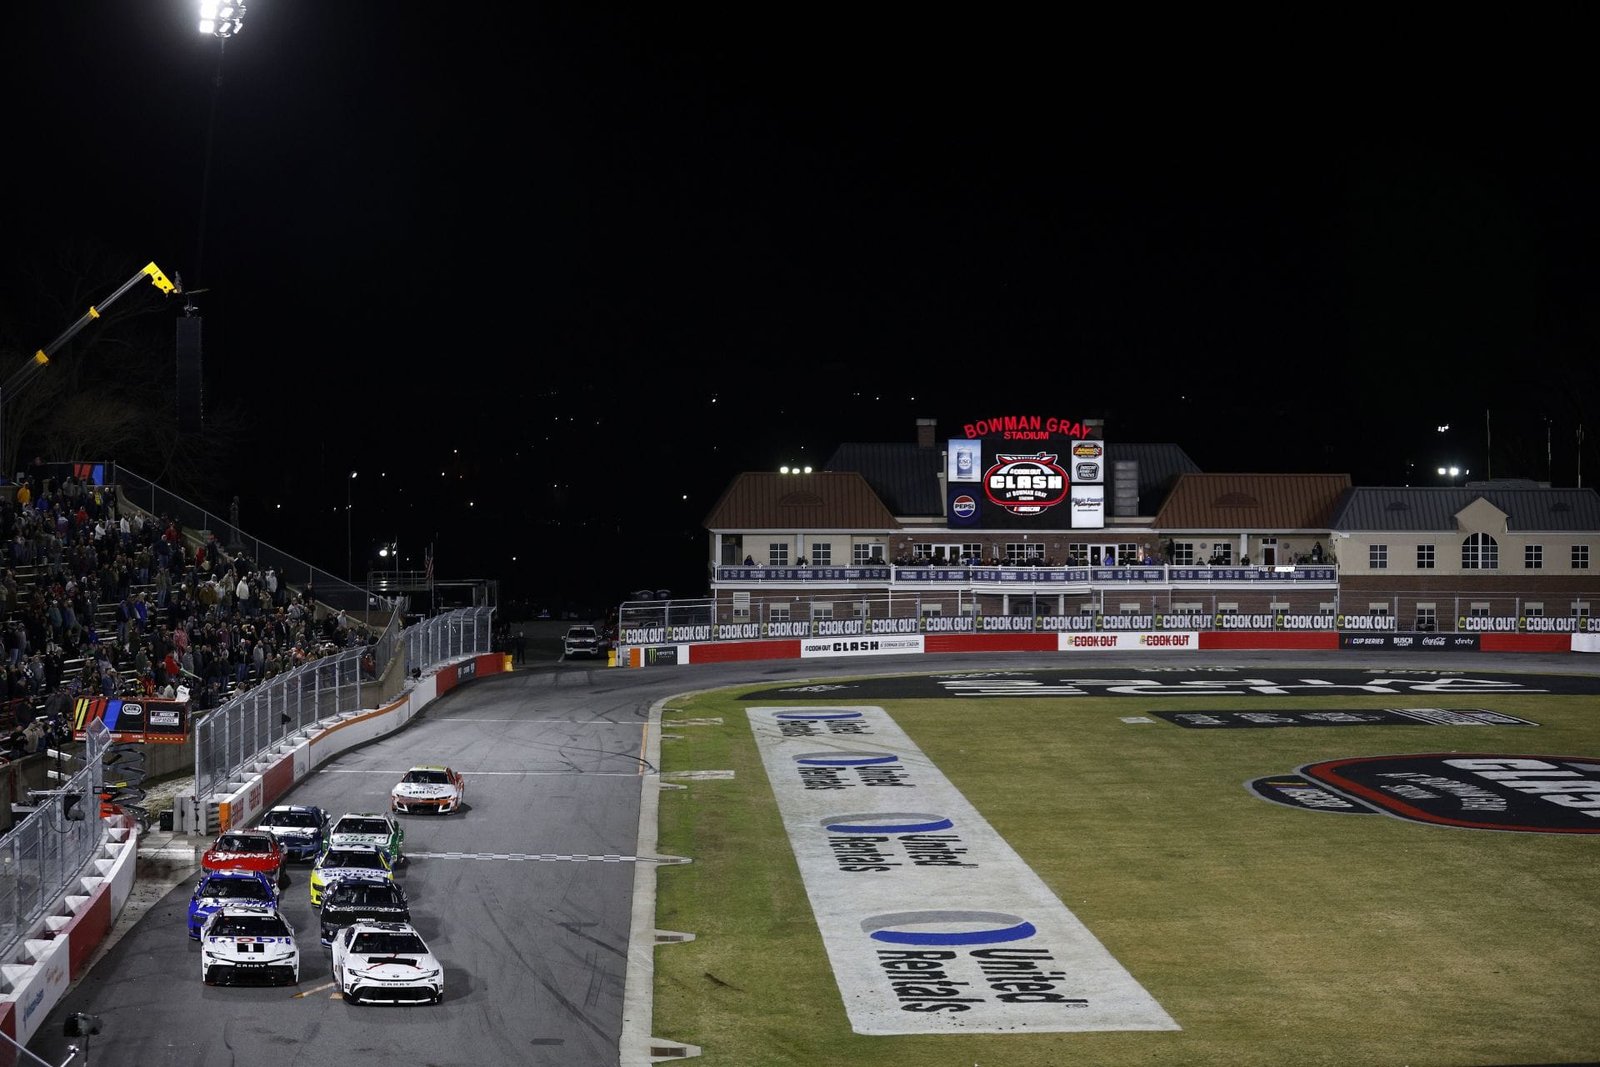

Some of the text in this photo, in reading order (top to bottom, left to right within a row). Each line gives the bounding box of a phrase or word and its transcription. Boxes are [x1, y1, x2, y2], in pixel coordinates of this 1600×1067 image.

[964, 416, 1092, 439] BOWMAN GRAY
[1004, 432, 1049, 440] STADIUM
[990, 475, 1062, 489] CLASH
[819, 620, 862, 635] COOK OUT
[872, 619, 916, 633] COOK OUT
[926, 617, 972, 630] COOK OUT
[983, 616, 1032, 630] COOK OUT
[1043, 616, 1091, 630] COOK OUT
[1103, 616, 1152, 629] COOK OUT
[1163, 616, 1211, 628] COOK OUT
[1223, 615, 1272, 628] COOK OUT
[1284, 616, 1334, 628] COOK OUT
[1345, 616, 1395, 629] COOK OUT
[1466, 618, 1516, 630] COOK OUT
[1526, 618, 1576, 631] COOK OUT
[626, 628, 664, 644] COOK OUT
[673, 626, 710, 641] COOK OUT
[719, 624, 759, 639] COOK OUT
[768, 622, 810, 636] COOK OUT
[833, 641, 879, 651] CLASH
[1075, 635, 1117, 647] COOK OUT
[1147, 635, 1190, 646] COOK OUT
[1442, 758, 1600, 818] CLAS
[828, 836, 902, 872] Rentals
[898, 834, 976, 868] United
[876, 950, 986, 1012] Rentals
[969, 948, 1089, 1004] United
